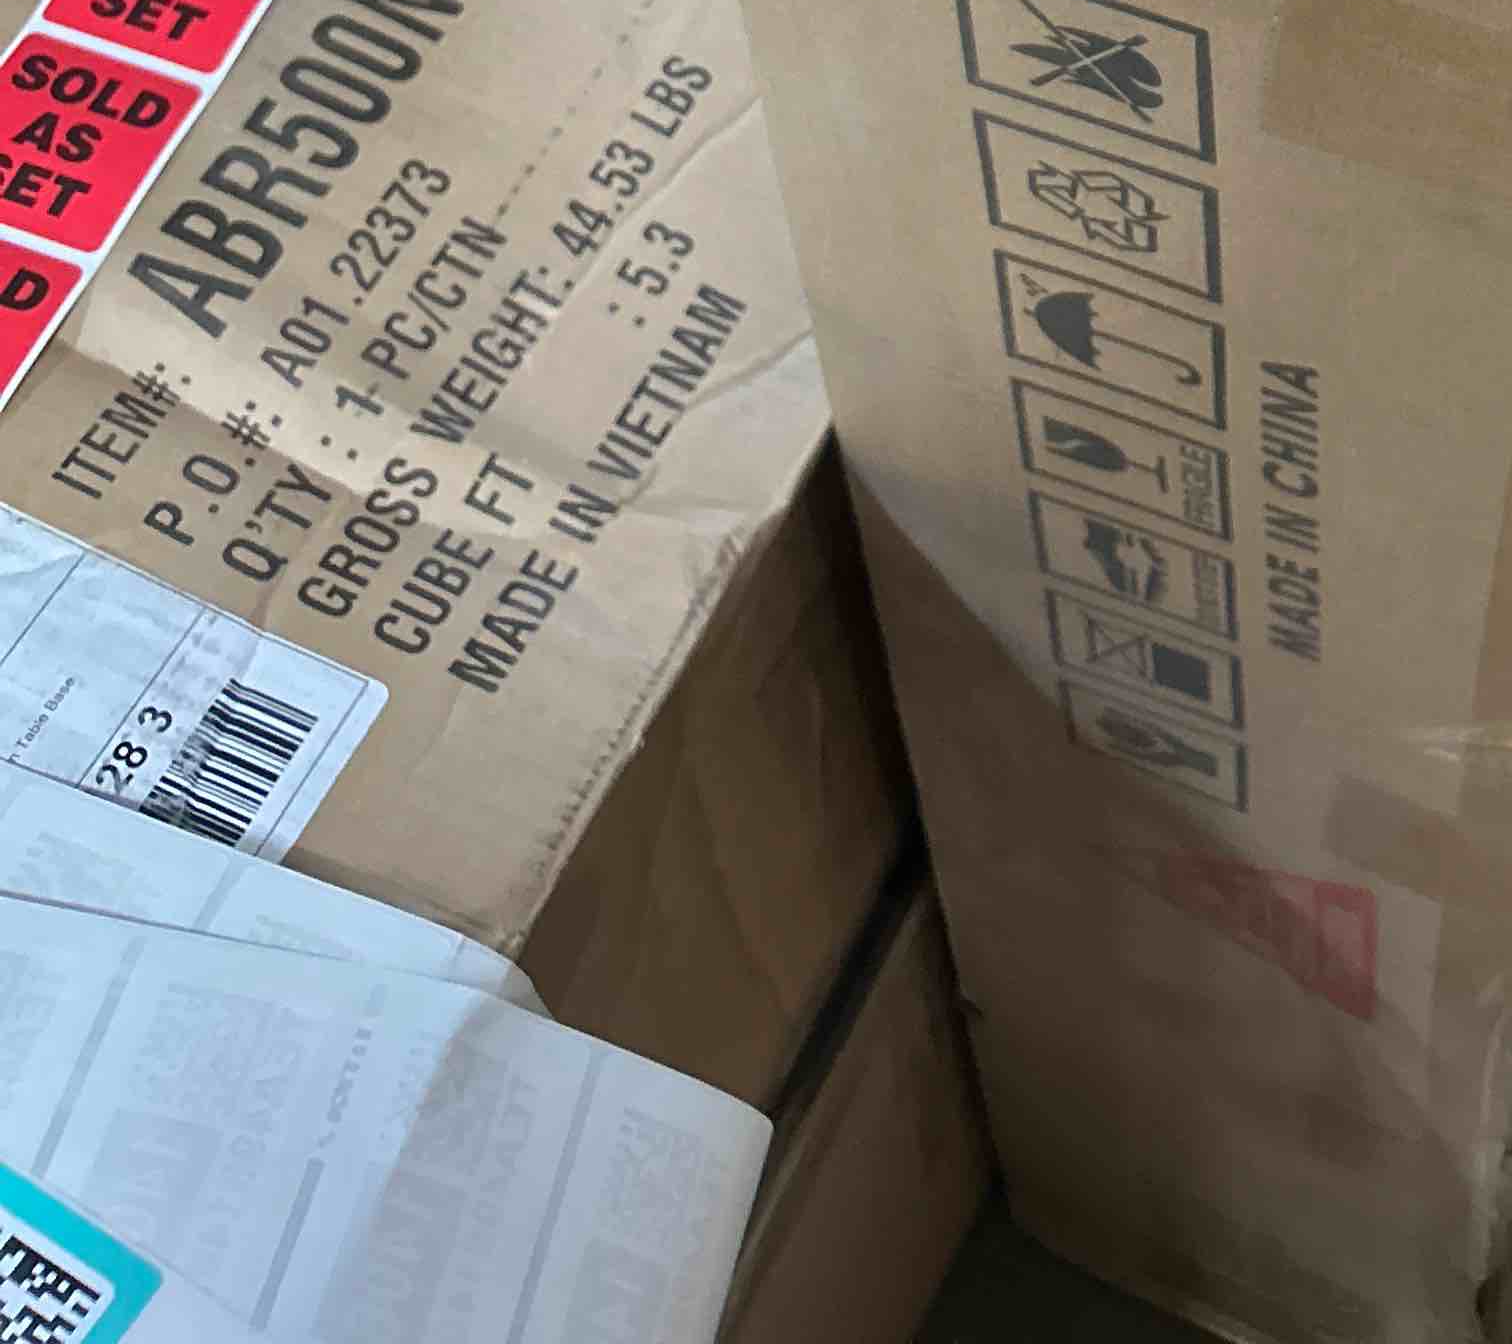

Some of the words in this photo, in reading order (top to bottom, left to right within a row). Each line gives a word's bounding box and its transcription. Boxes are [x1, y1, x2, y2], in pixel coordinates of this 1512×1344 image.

[11, 55, 171, 129] SOLD
[11, 111, 102, 163] AS
[260, 158, 453, 390] A01.22373
[297, 457, 440, 620] GROSS
[410, 265, 576, 449] WEIGHT:
[552, 137, 657, 262] 44.53
[643, 55, 714, 143] LBS
[52, 362, 193, 500] ITEM#:
[222, 464, 333, 585] Q'TY
[361, 214, 509, 382] PC/CTN
[373, 528, 497, 657] CUBE
[463, 451, 537, 528] FT
[618, 220, 696, 299] 5.3
[1260, 361, 1318, 497] CHINA
[447, 548, 580, 694] MADE
[549, 487, 606, 546] IN
[588, 283, 749, 486] VIETNAM
[1264, 503, 1320, 554] IN
[1266, 552, 1321, 663] MADE
[16, 714, 48, 748] Table
[44, 677, 74, 712] Base
[96, 741, 148, 795] 28
[138, 706, 172, 733] 3
